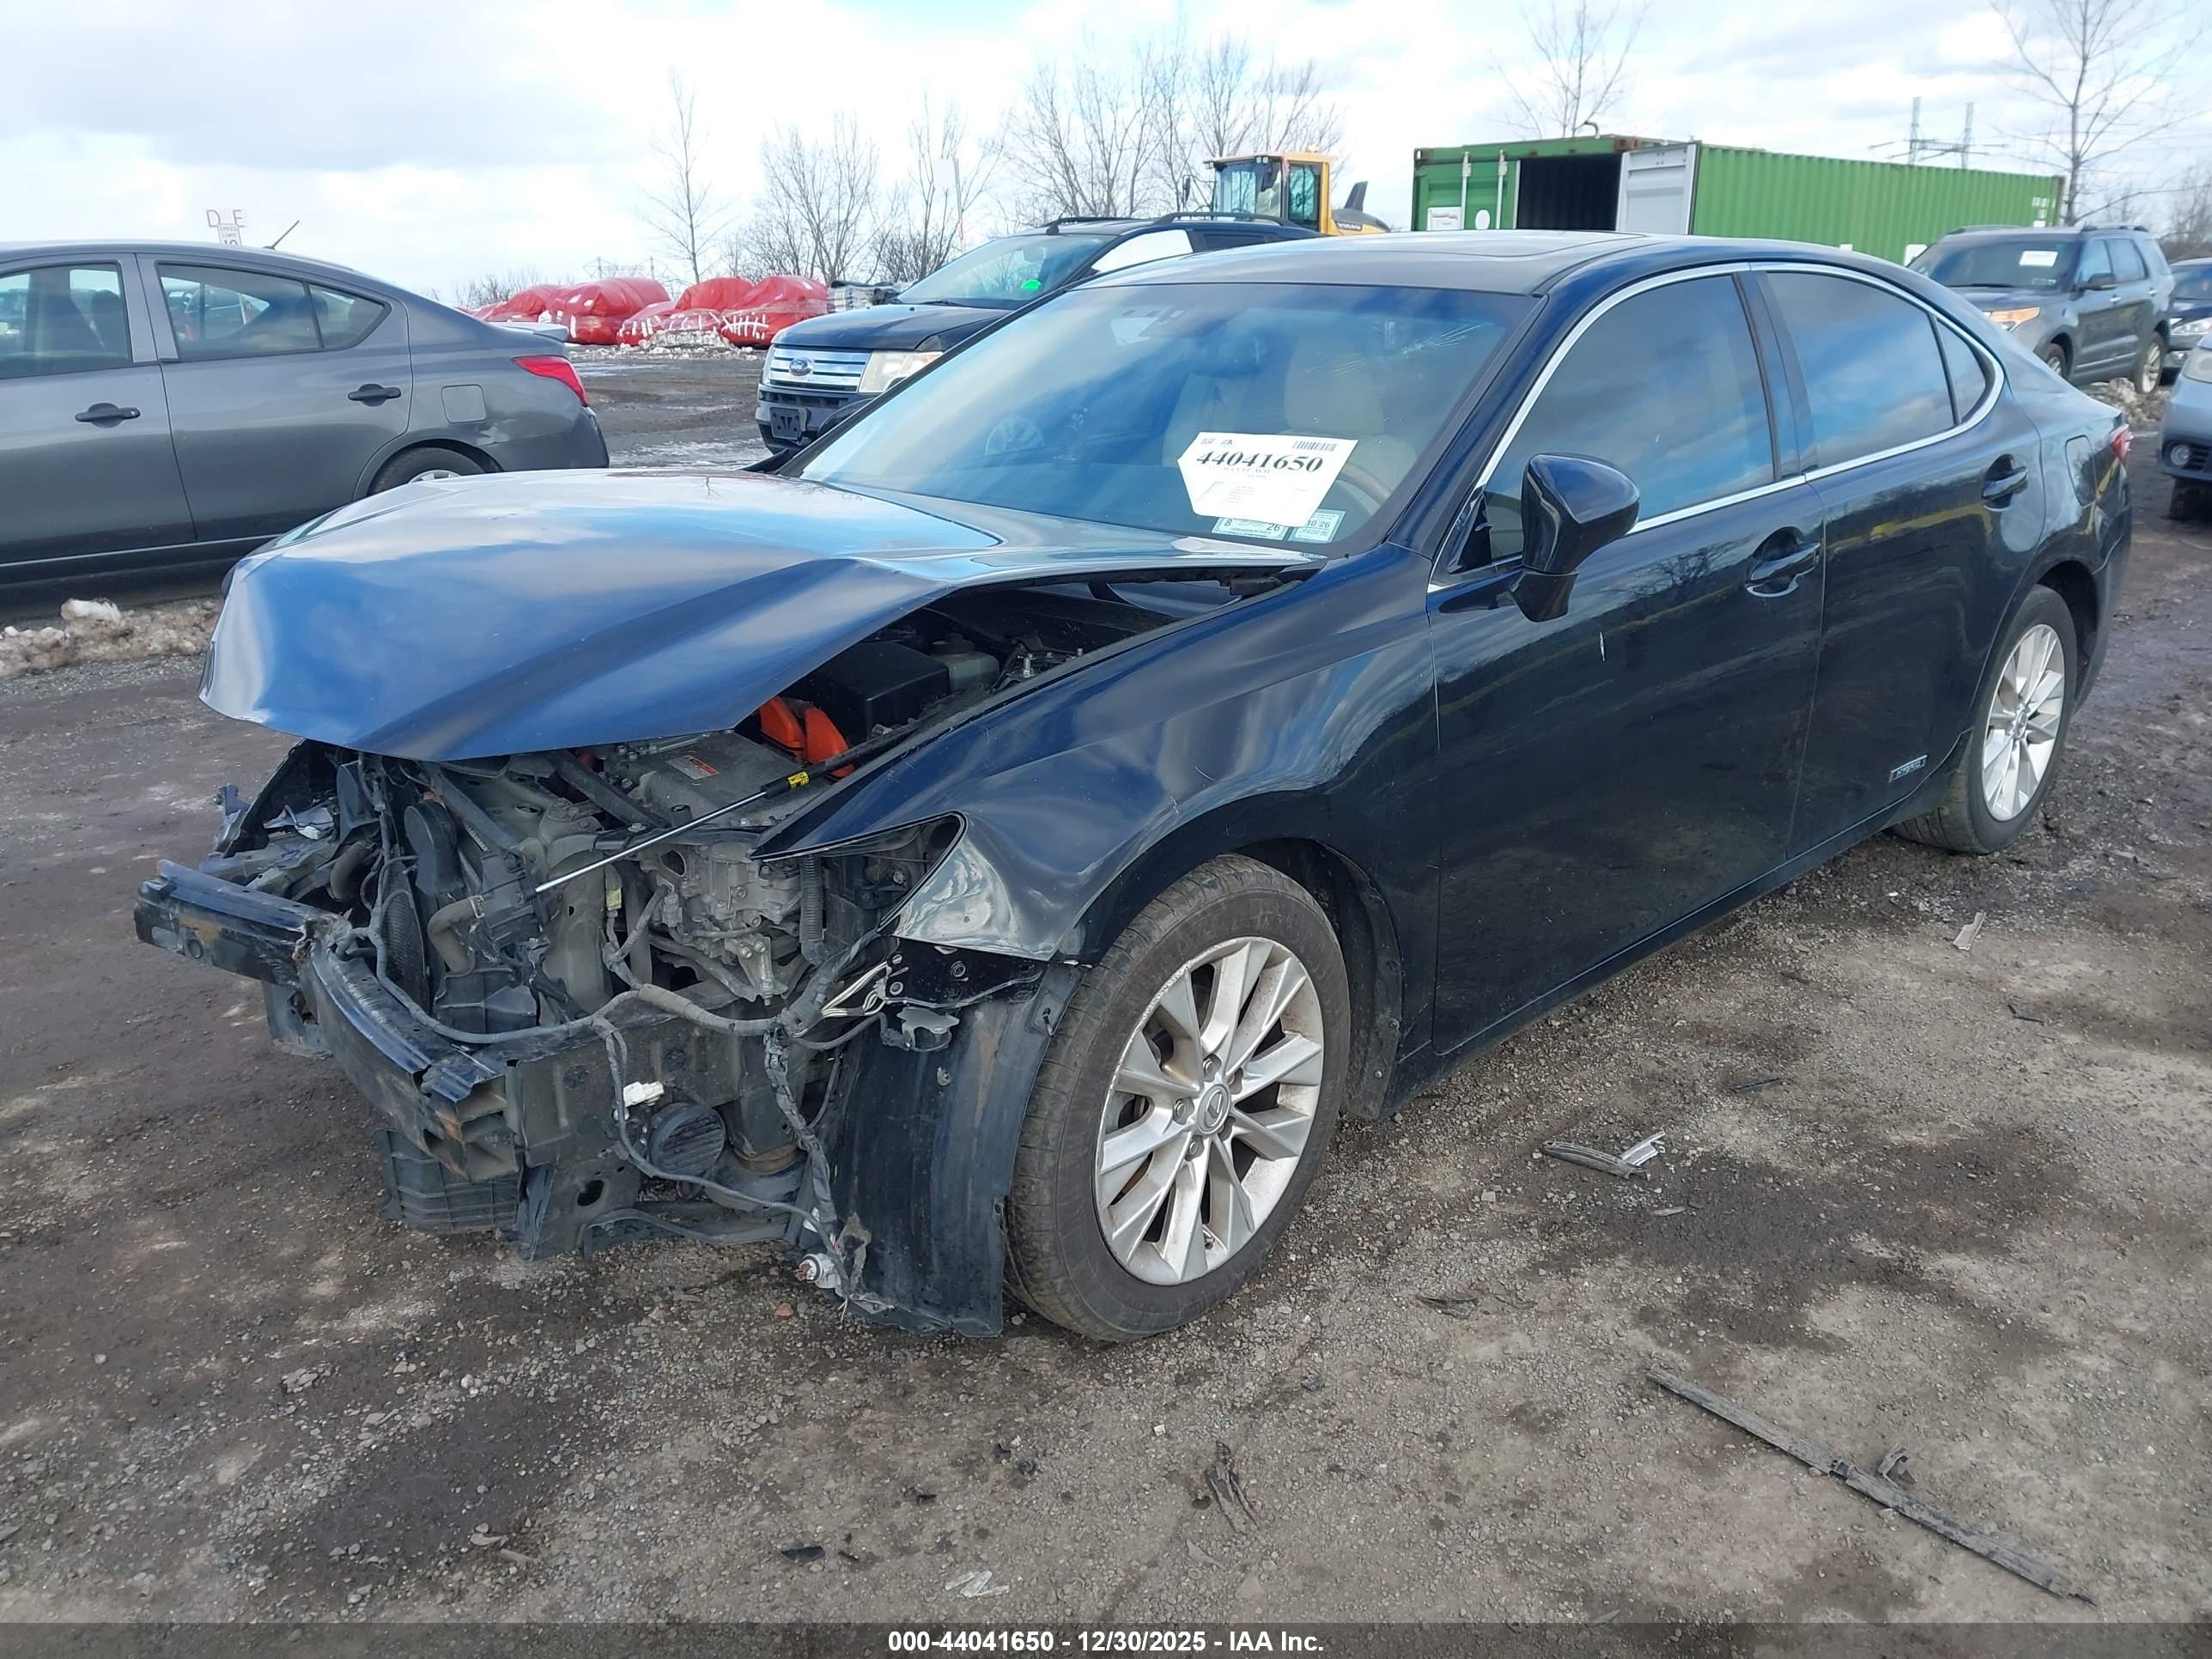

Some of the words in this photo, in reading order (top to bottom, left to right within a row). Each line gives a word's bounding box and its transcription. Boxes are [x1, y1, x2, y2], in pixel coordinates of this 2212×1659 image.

[206, 210, 220, 227] D
[233, 210, 245, 227] E
[1196, 451, 1323, 472] 44041650
[1224, 519, 1233, 527] 8
[1266, 522, 1280, 532] 26
